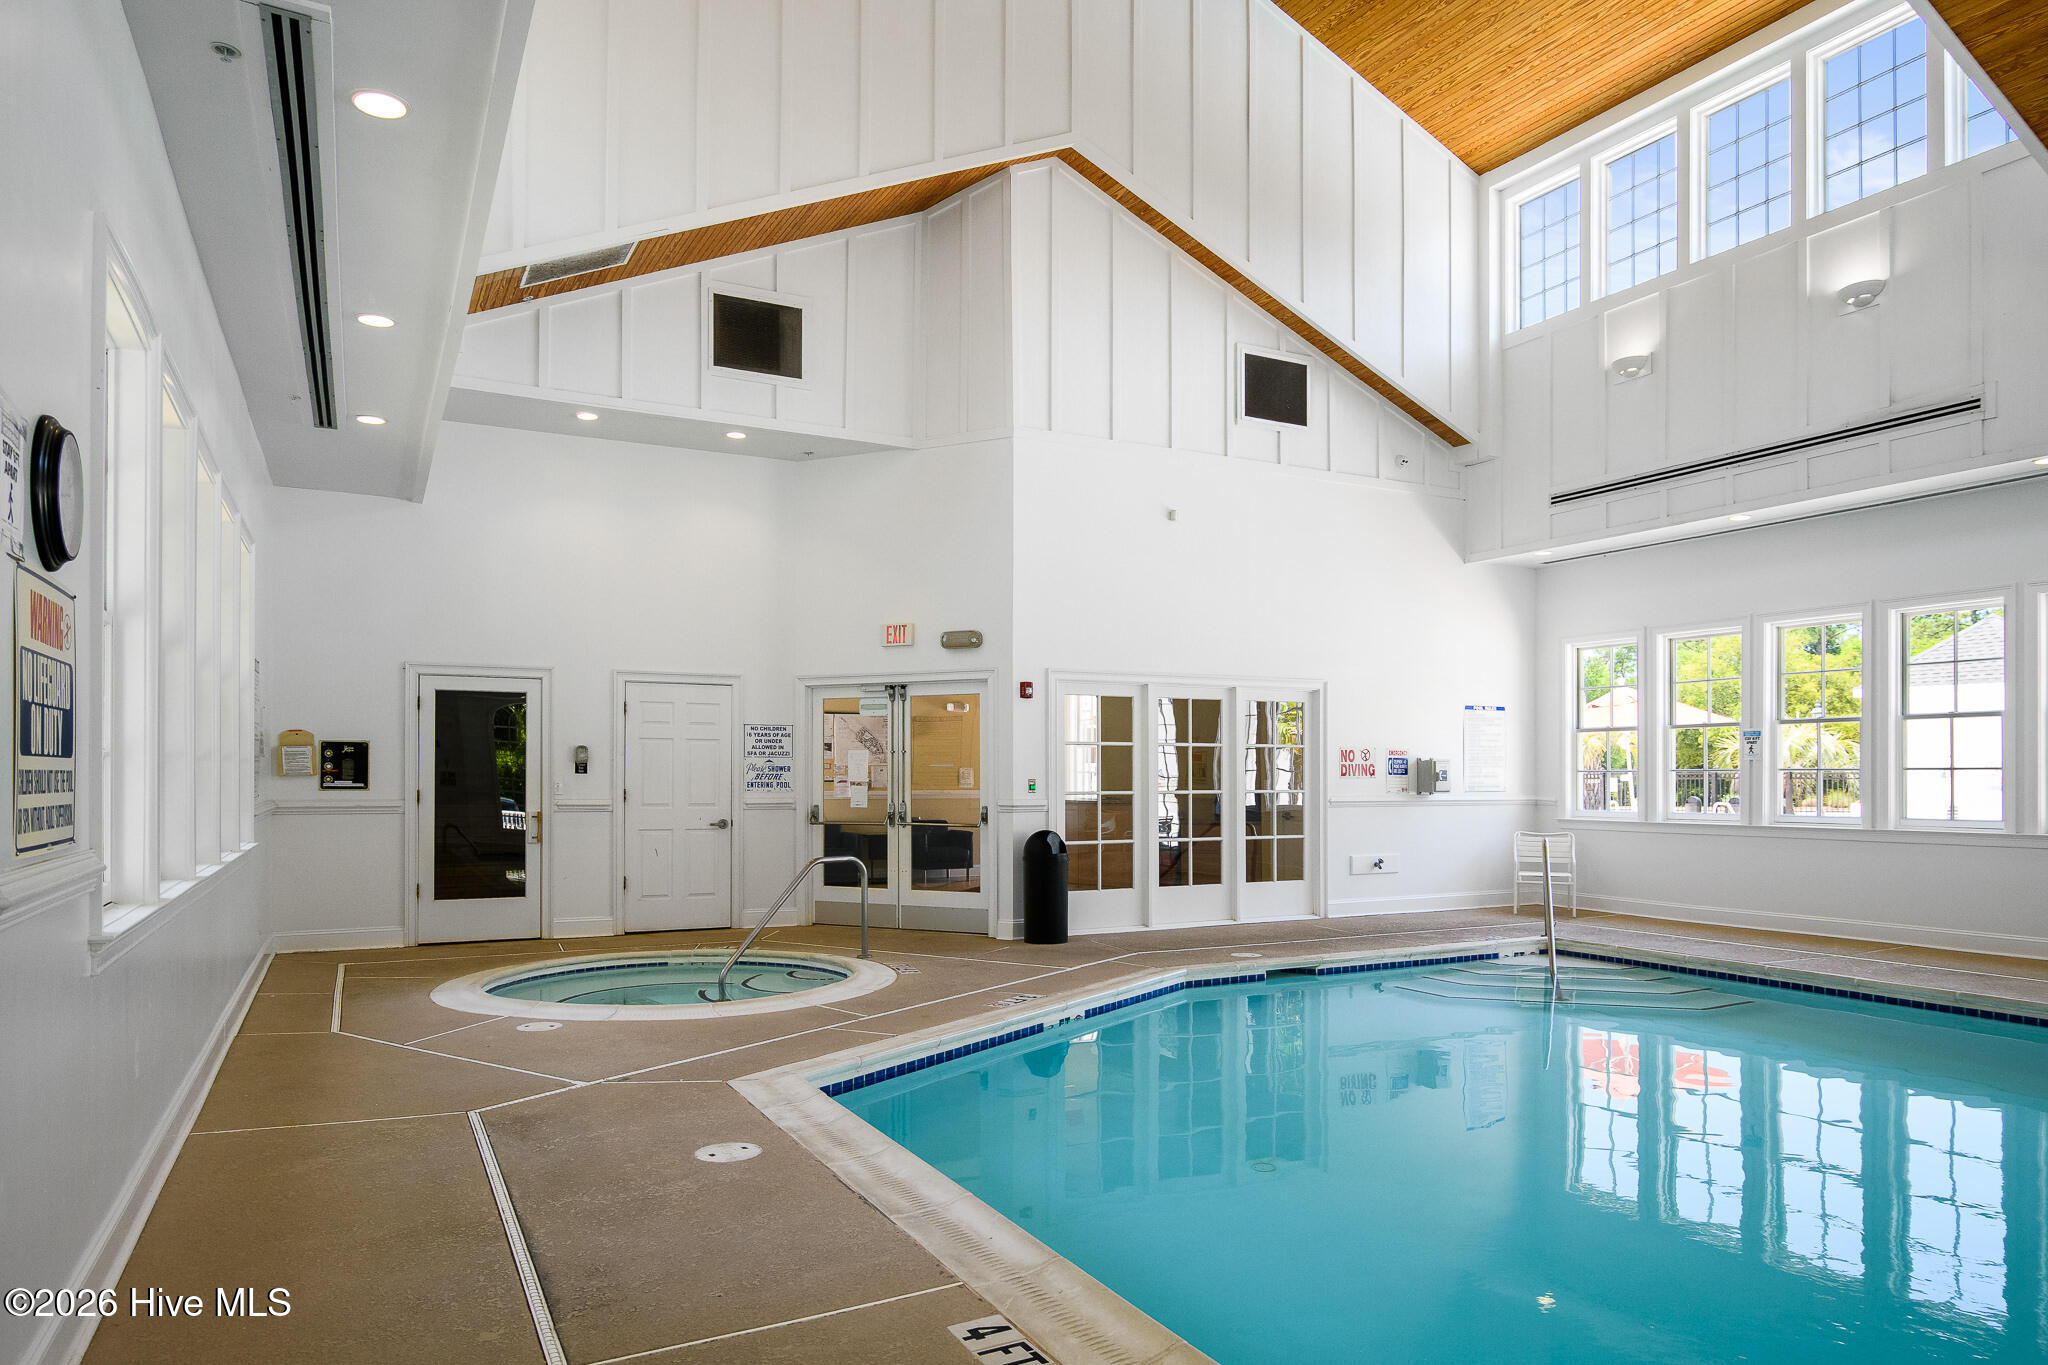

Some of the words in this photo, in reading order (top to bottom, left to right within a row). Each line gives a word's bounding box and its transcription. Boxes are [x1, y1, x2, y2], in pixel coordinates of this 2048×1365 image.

[4, 460, 18, 482] APART
[30, 589, 63, 651] WARNING
[886, 624, 907, 644] EXIT
[22, 649, 33, 702] NO
[33, 653, 71, 710] LIFEGUARD
[30, 703, 42, 755] ON
[43, 707, 63, 756] DUTY
[1340, 749, 1355, 762] NO
[1340, 763, 1376, 777] DIVING
[962, 1325, 1013, 1341] 4
[977, 1341, 1050, 1365] FT
